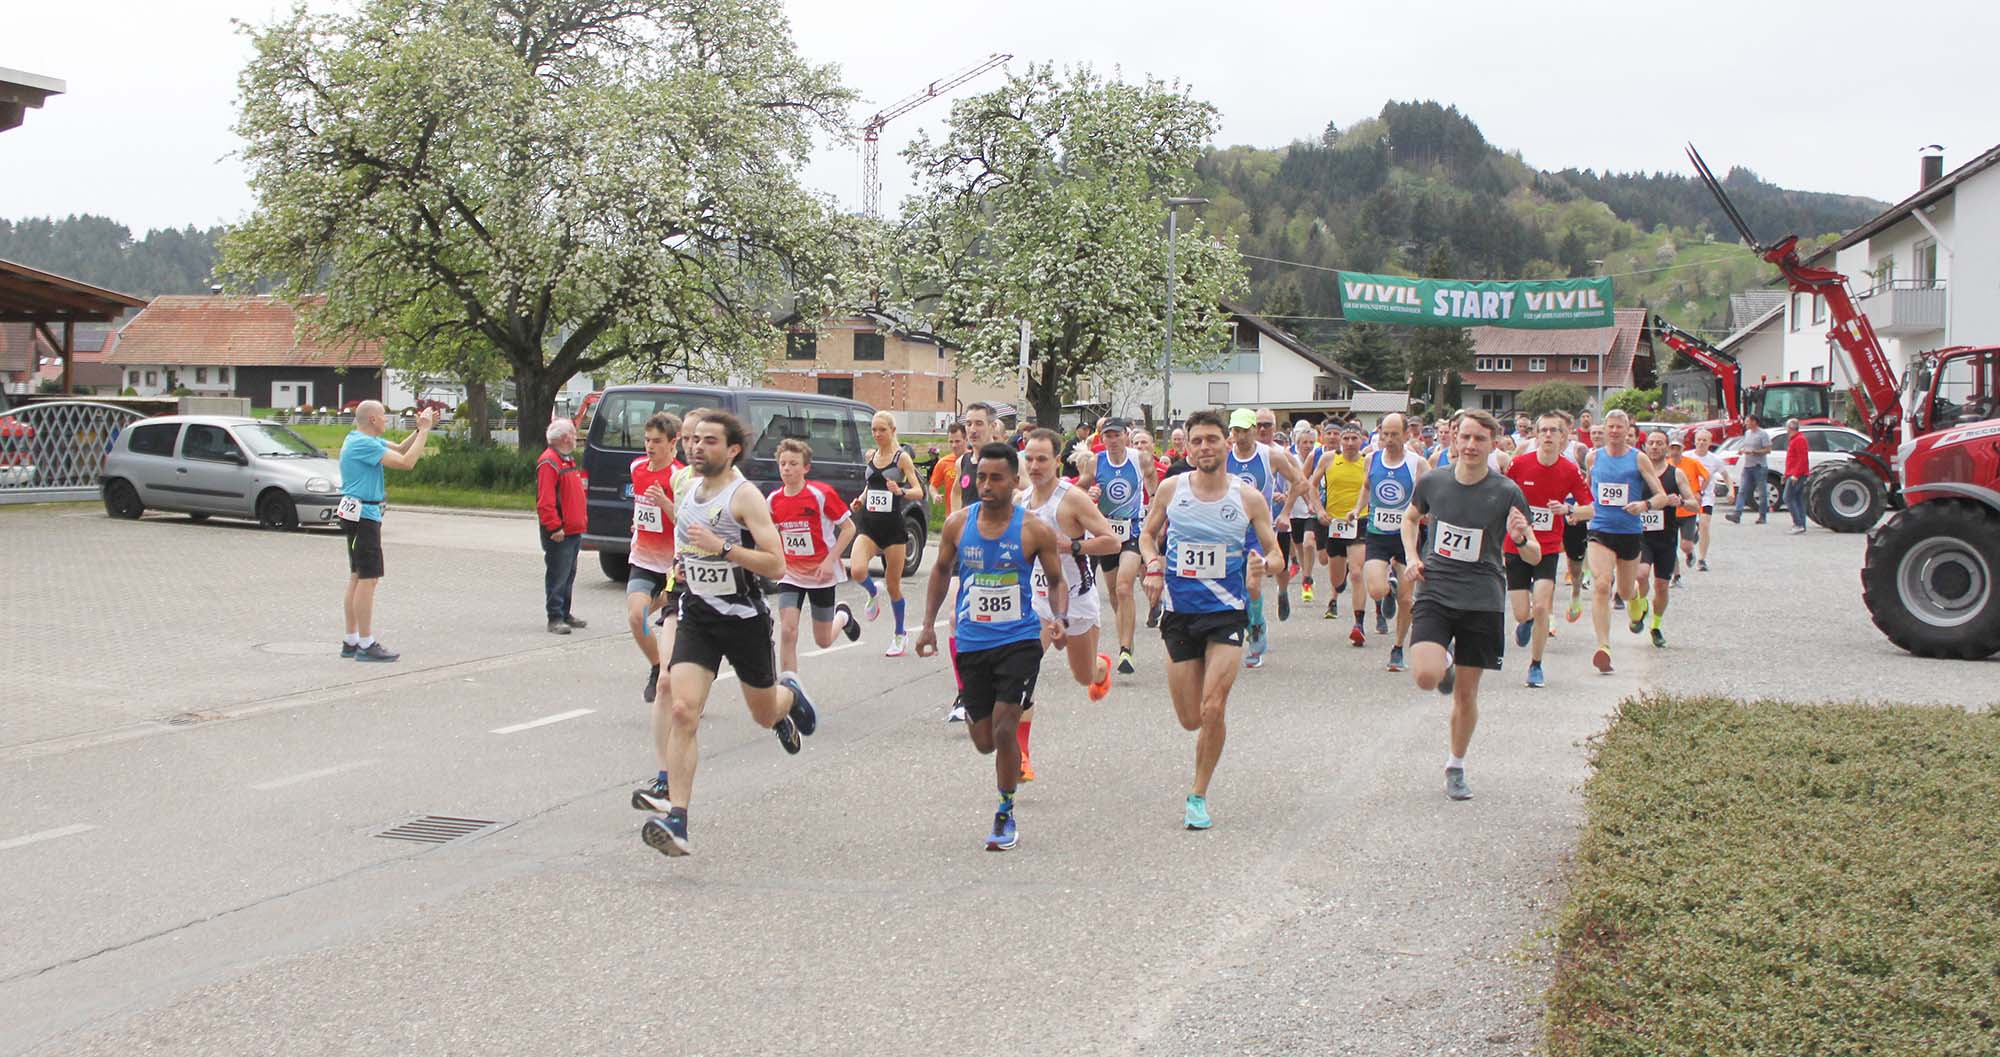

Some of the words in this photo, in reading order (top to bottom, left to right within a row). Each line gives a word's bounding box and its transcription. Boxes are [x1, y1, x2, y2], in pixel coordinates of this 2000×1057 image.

[1344, 282, 1422, 305] VIVIL
[1433, 289, 1515, 319] START
[1525, 289, 1604, 310] VIVIL
[1602, 488, 1623, 498] 299
[870, 496, 887, 505] 353
[638, 511, 655, 523] 245
[1377, 512, 1402, 524] 1255
[1532, 512, 1549, 523] 23
[1641, 515, 1658, 524] 302
[787, 537, 806, 547] 244
[1442, 531, 1471, 550] 271
[1186, 550, 1215, 566] 311
[689, 566, 728, 583] 1237
[979, 596, 1011, 612] 385
